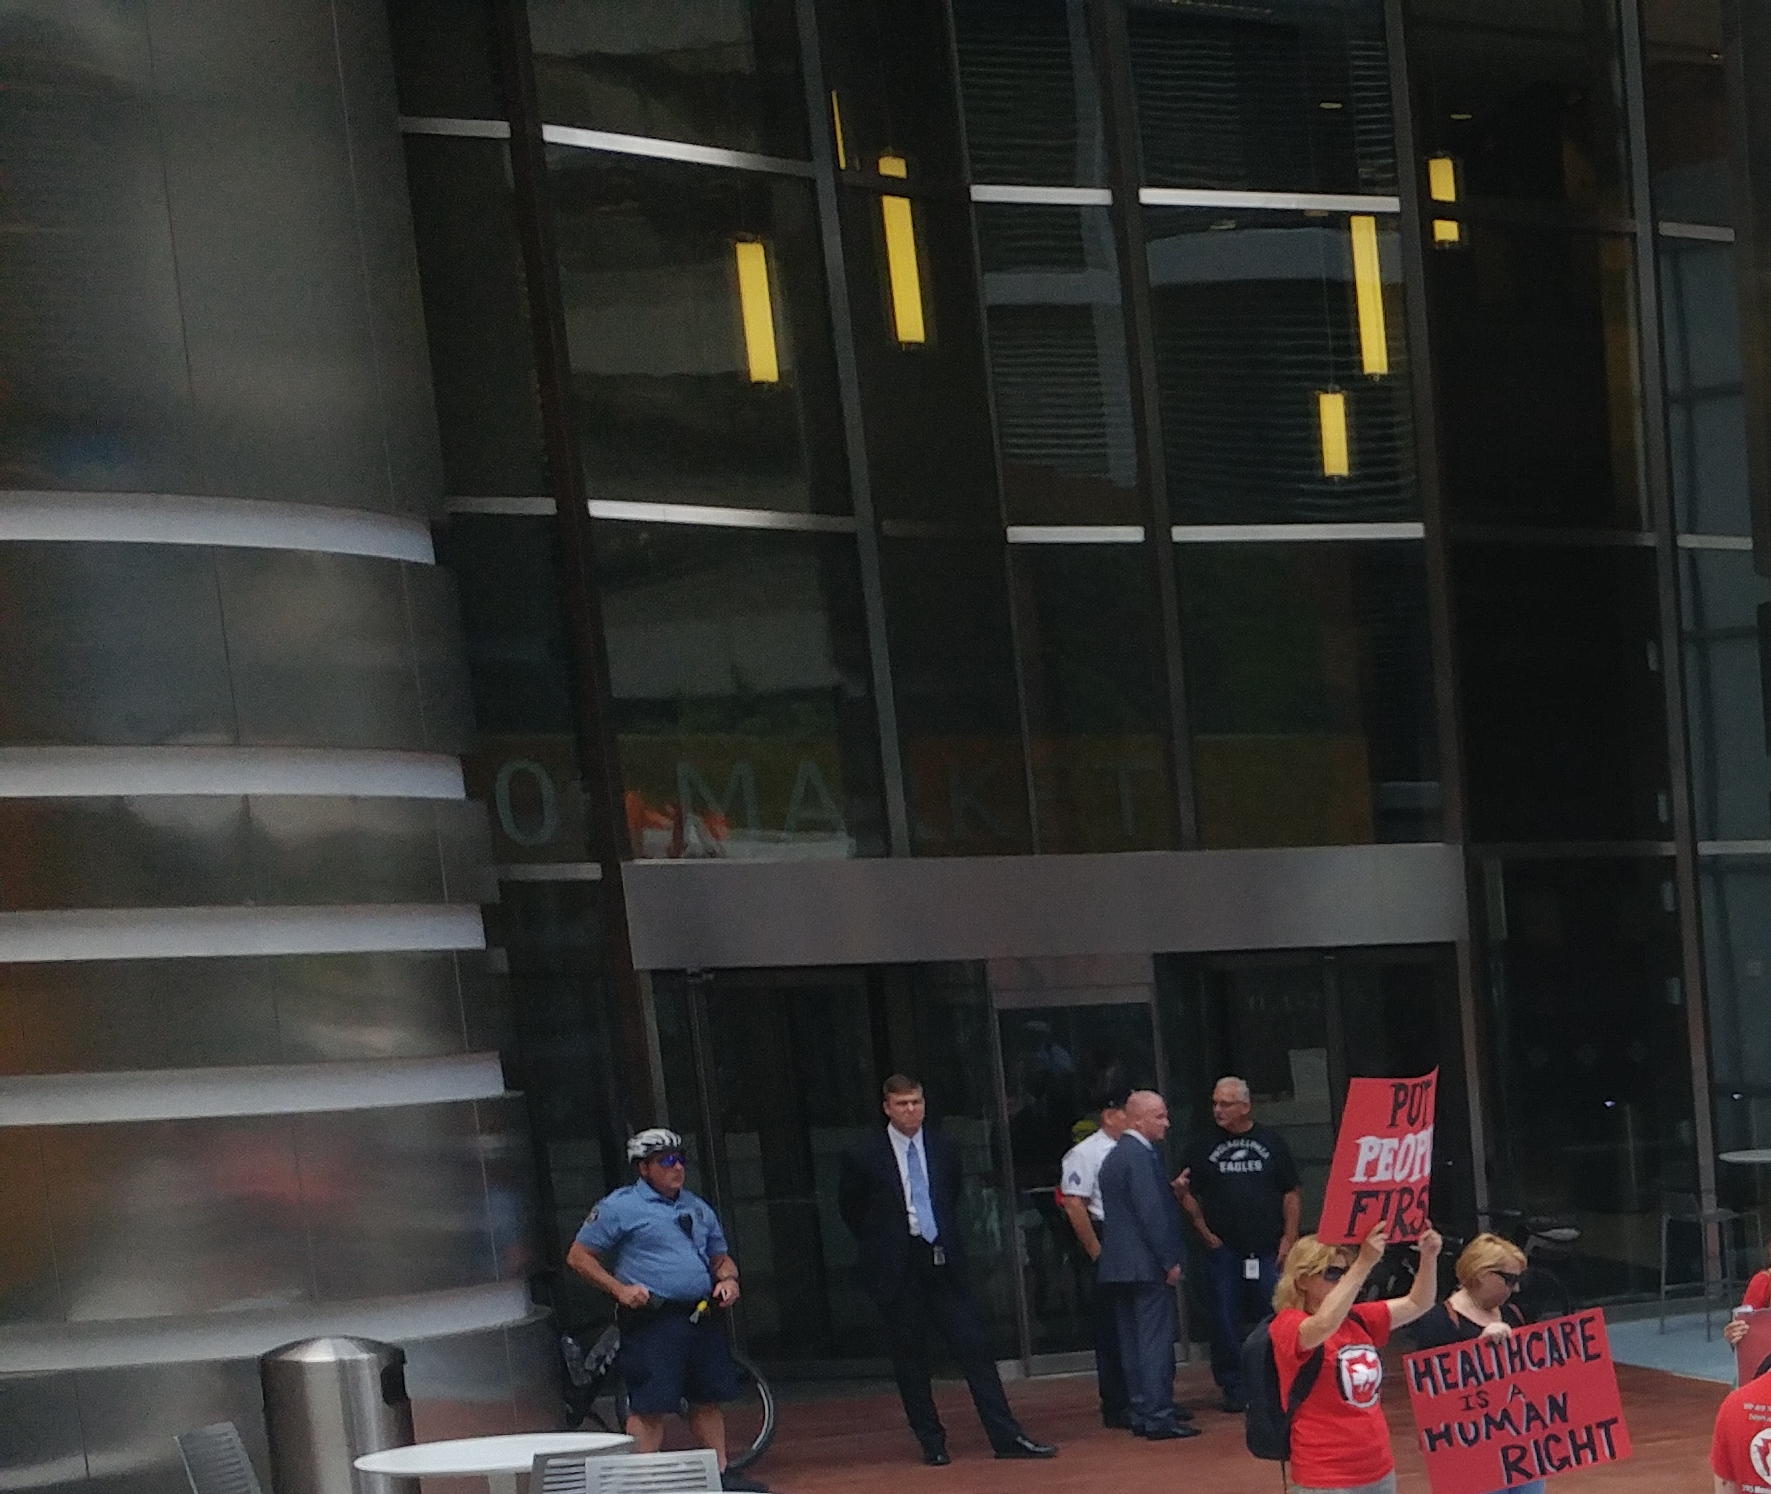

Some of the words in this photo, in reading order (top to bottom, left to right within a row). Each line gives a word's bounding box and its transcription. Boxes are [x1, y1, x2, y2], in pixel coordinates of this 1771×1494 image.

[1388, 1080, 1433, 1128] PUT
[1219, 1160, 1263, 1173] EAGLES
[1349, 1125, 1433, 1183] PEOPL
[1344, 1185, 1430, 1240] FIRS
[1408, 1316, 1600, 1398] HEALTHCARE
[1424, 1392, 1569, 1453] HUMAN
[1462, 1391, 1489, 1411] IS
[1507, 1383, 1526, 1404] A
[1500, 1417, 1619, 1484] RIGHT
